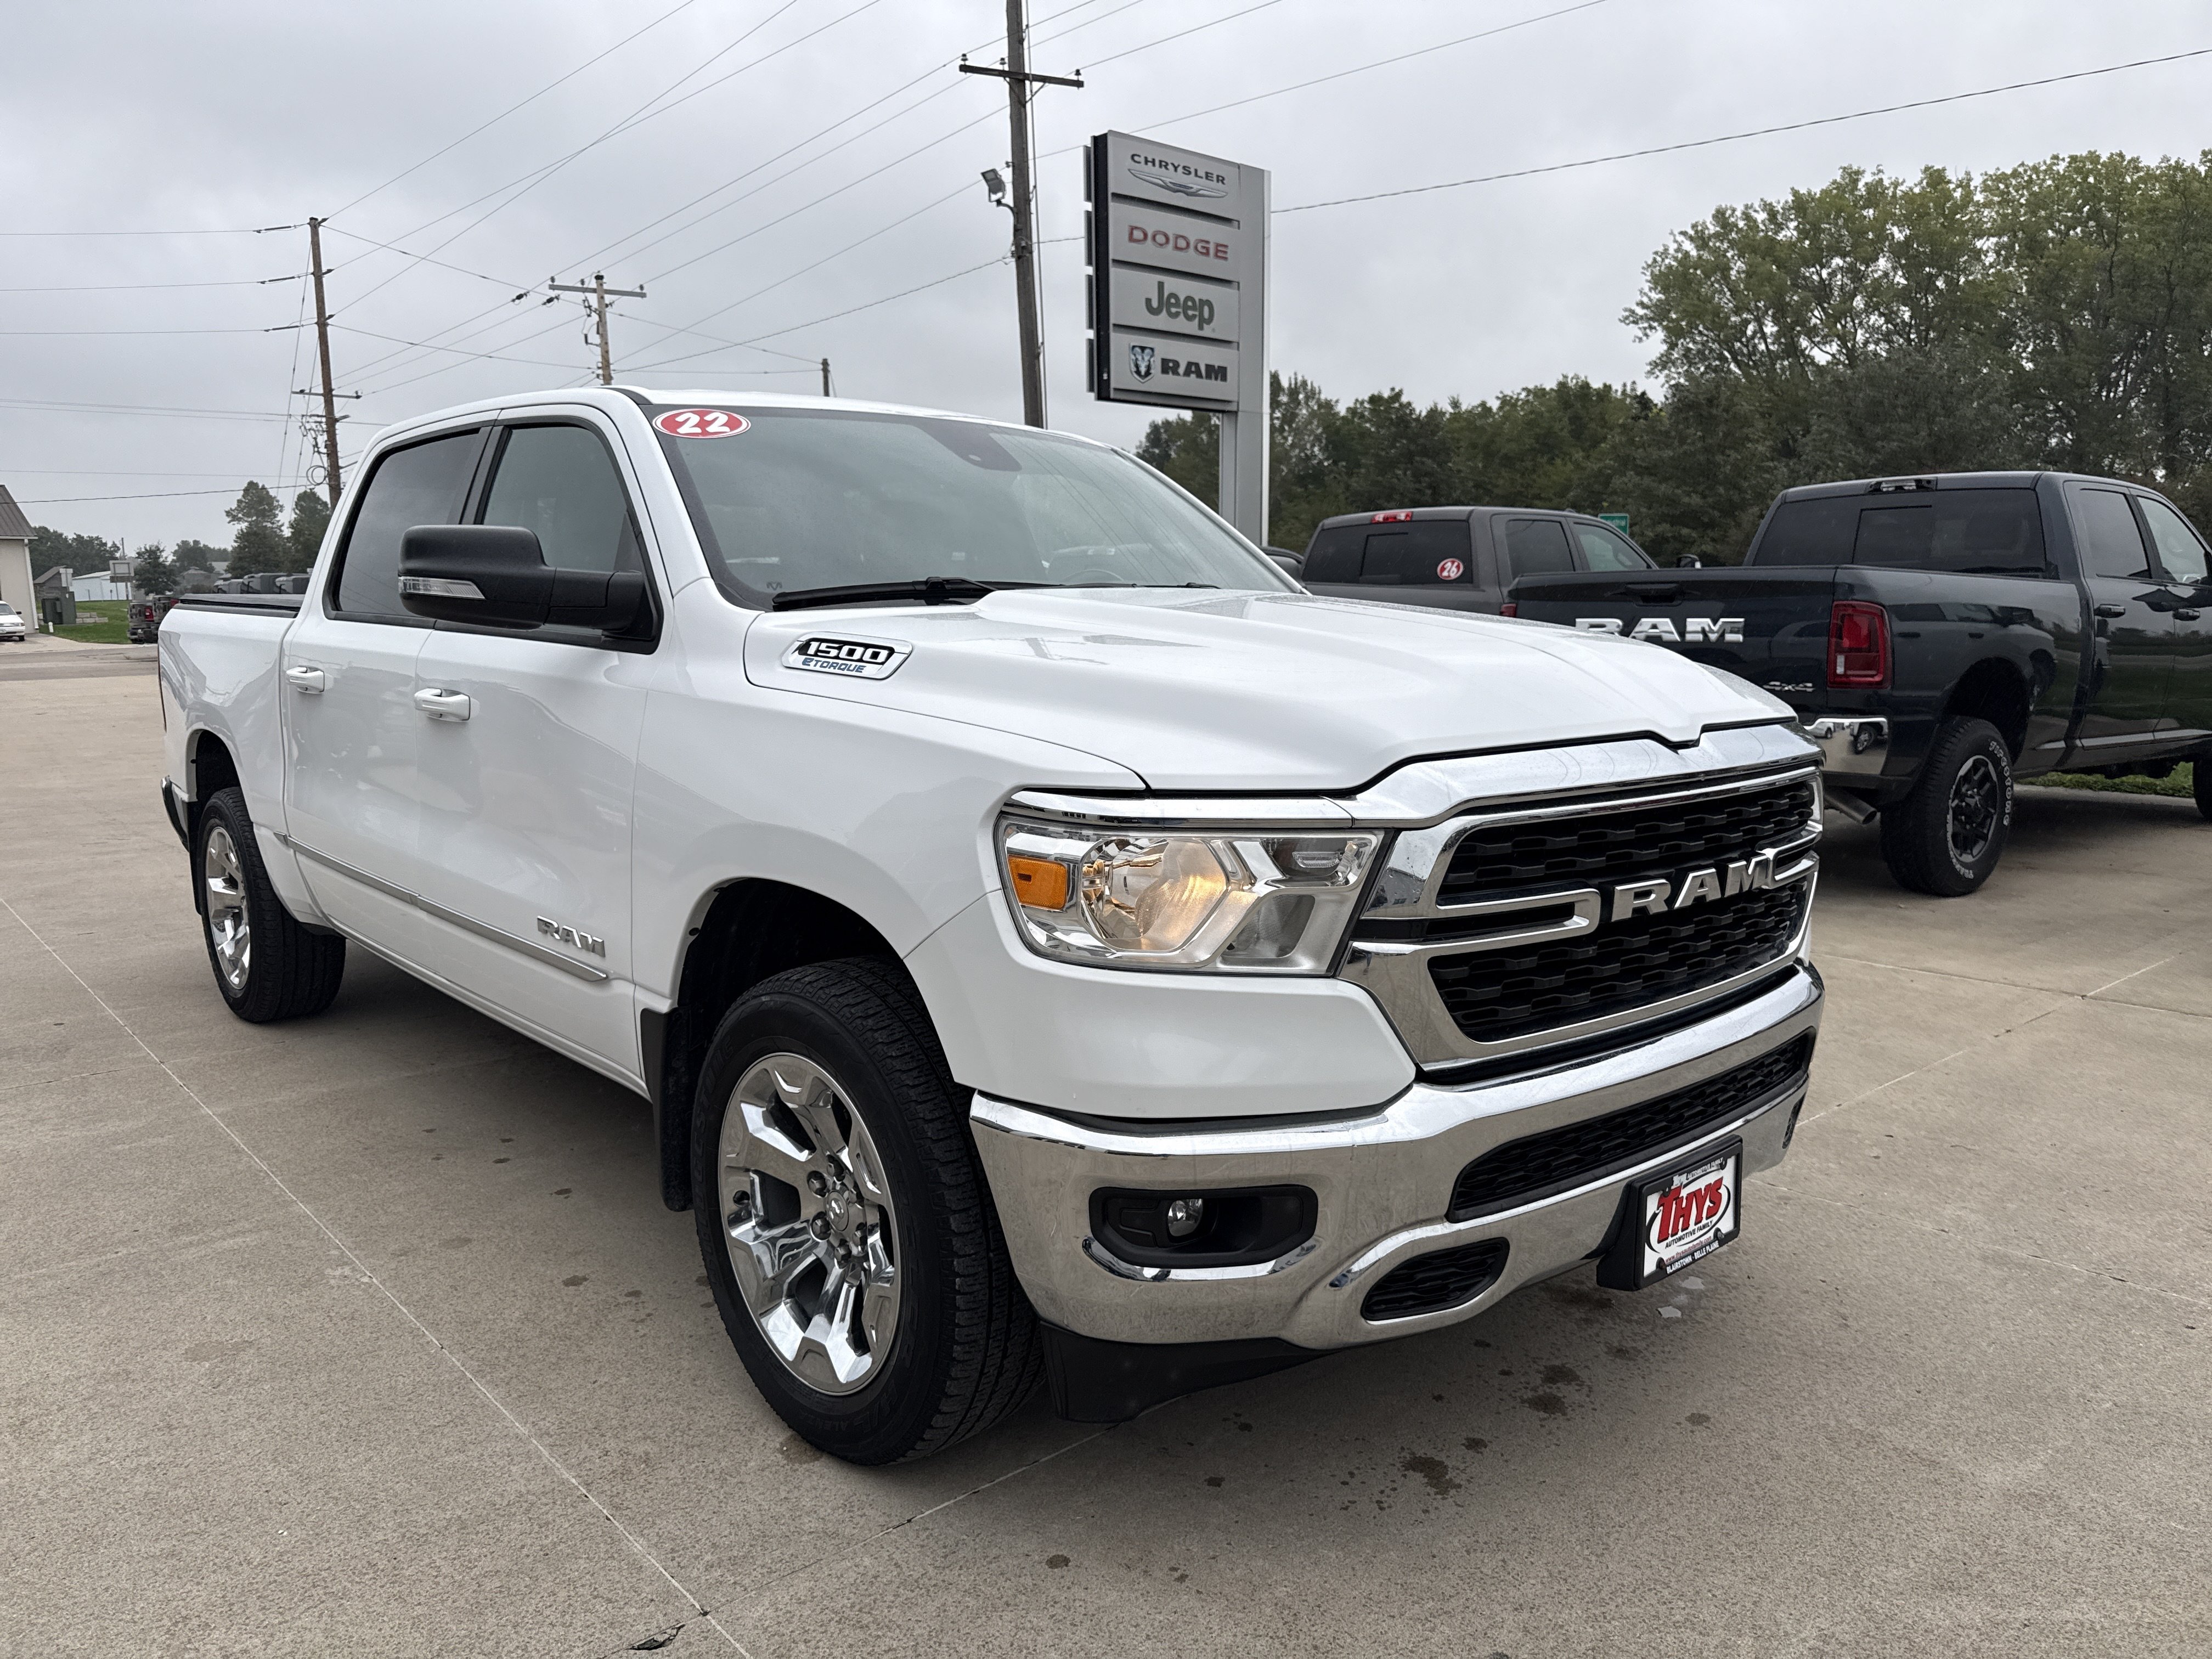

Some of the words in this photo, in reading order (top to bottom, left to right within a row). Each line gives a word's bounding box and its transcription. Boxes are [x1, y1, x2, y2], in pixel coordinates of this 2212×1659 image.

[1130, 154, 1226, 185] CHRYSLER
[1128, 225, 1229, 261] DODGE
[1145, 281, 1215, 330] Jeep
[1161, 358, 1228, 382] RAM
[675, 412, 731, 433] 22
[1442, 562, 1458, 577] 26
[1575, 618, 1745, 642] RAM
[806, 641, 889, 663] 1500
[1611, 855, 1771, 922] RAM
[537, 915, 606, 958] RAM
[1665, 1228, 1696, 1249] AUTOMOTIVE
[1696, 1220, 1713, 1233] FAMILY
